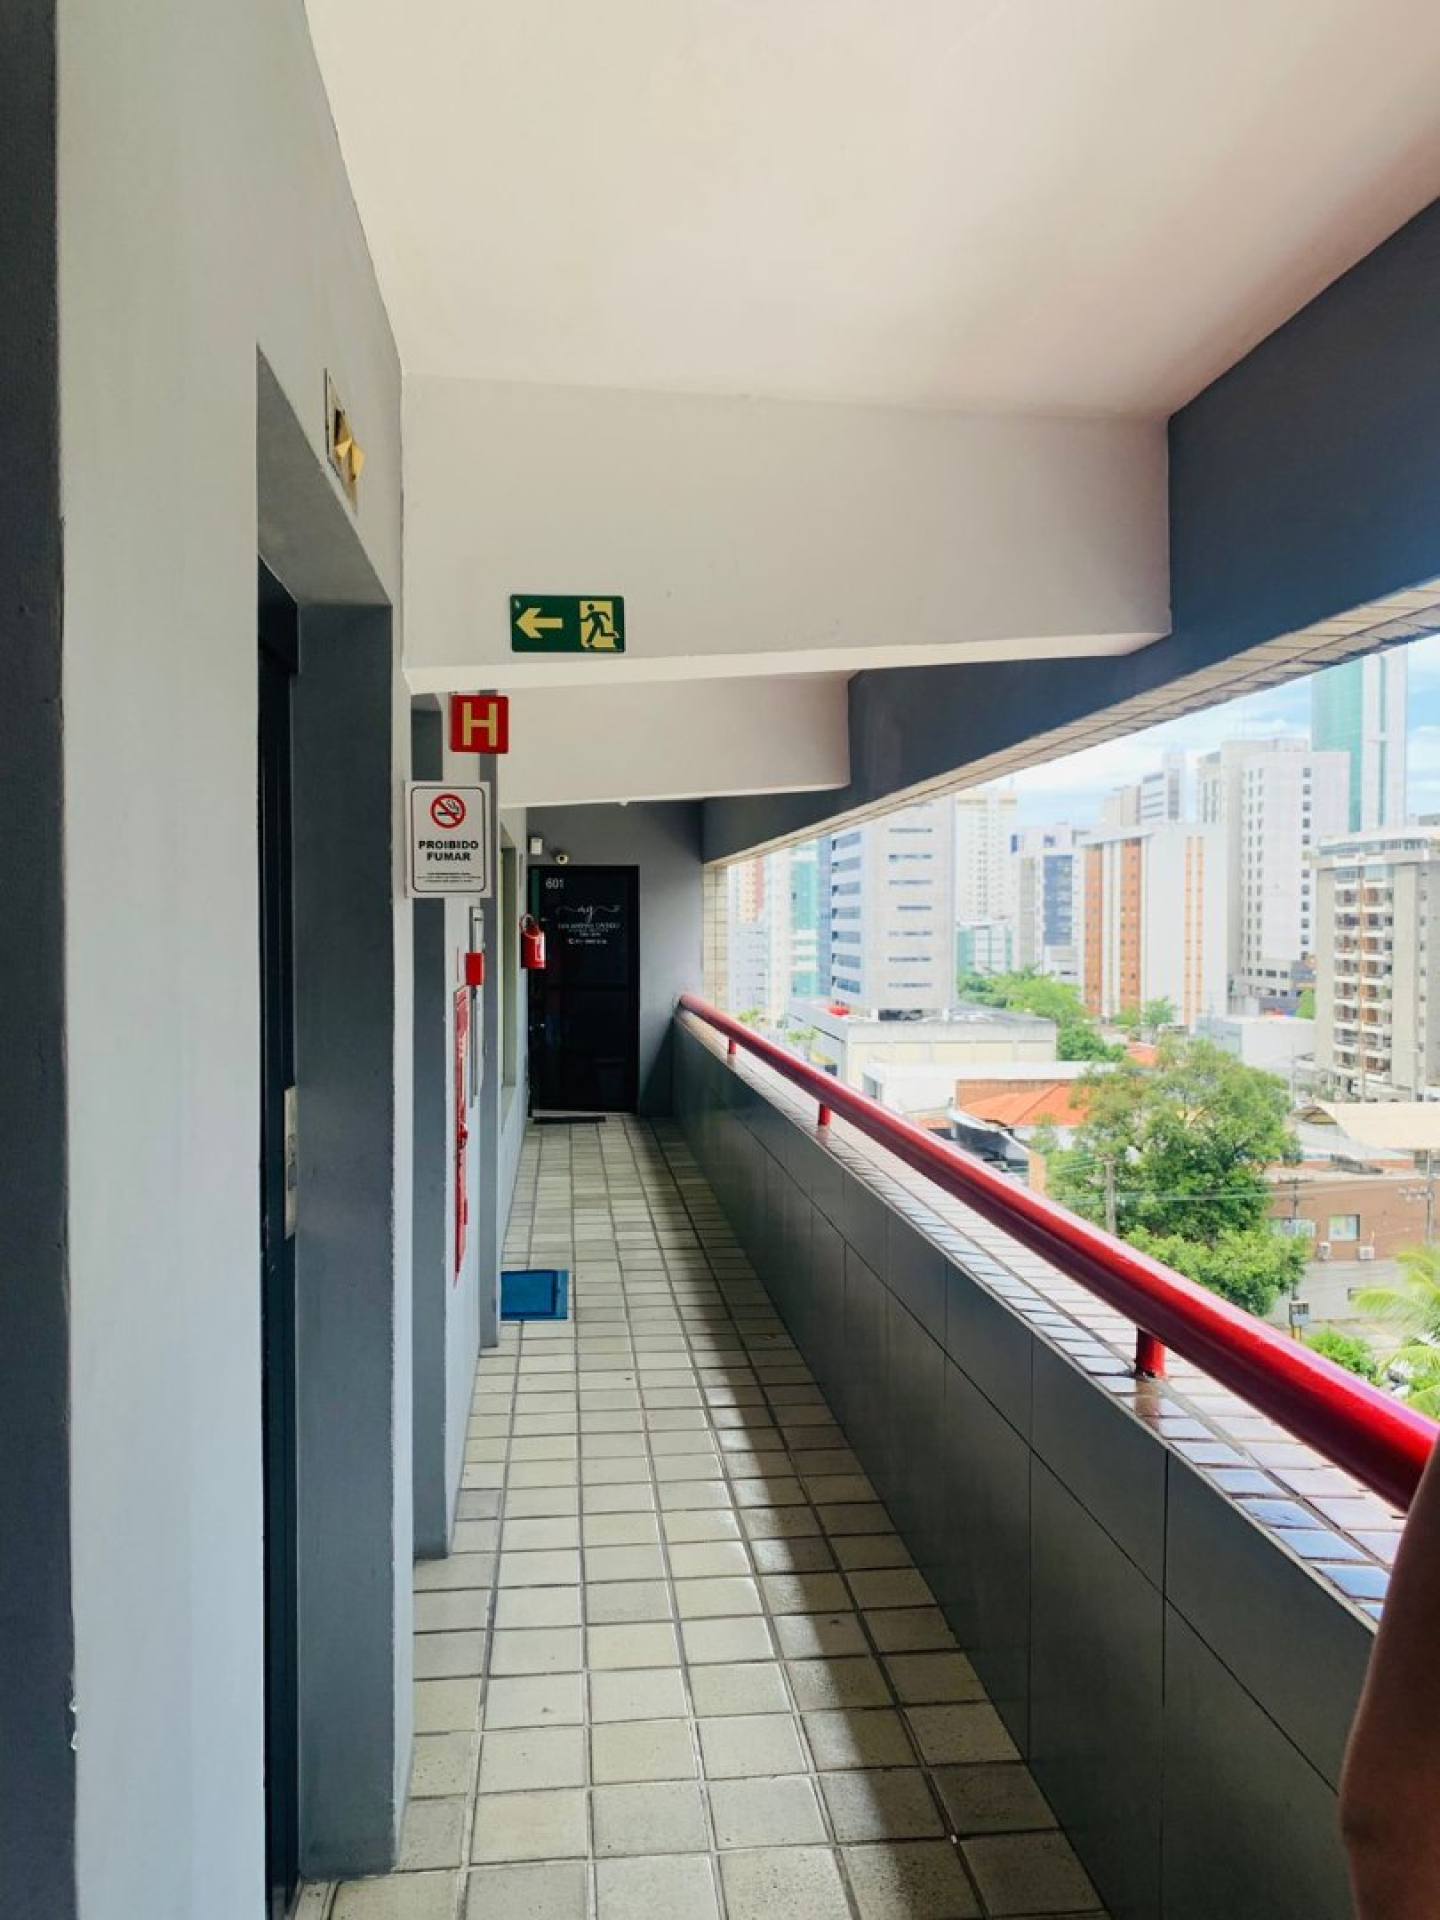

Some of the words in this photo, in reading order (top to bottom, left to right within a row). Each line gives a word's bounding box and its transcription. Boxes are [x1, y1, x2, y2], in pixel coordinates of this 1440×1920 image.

[462, 702, 498, 747] H
[418, 840, 479, 849] PROIBIDO
[426, 852, 471, 861] FUMAR
[545, 878, 564, 889] 601
